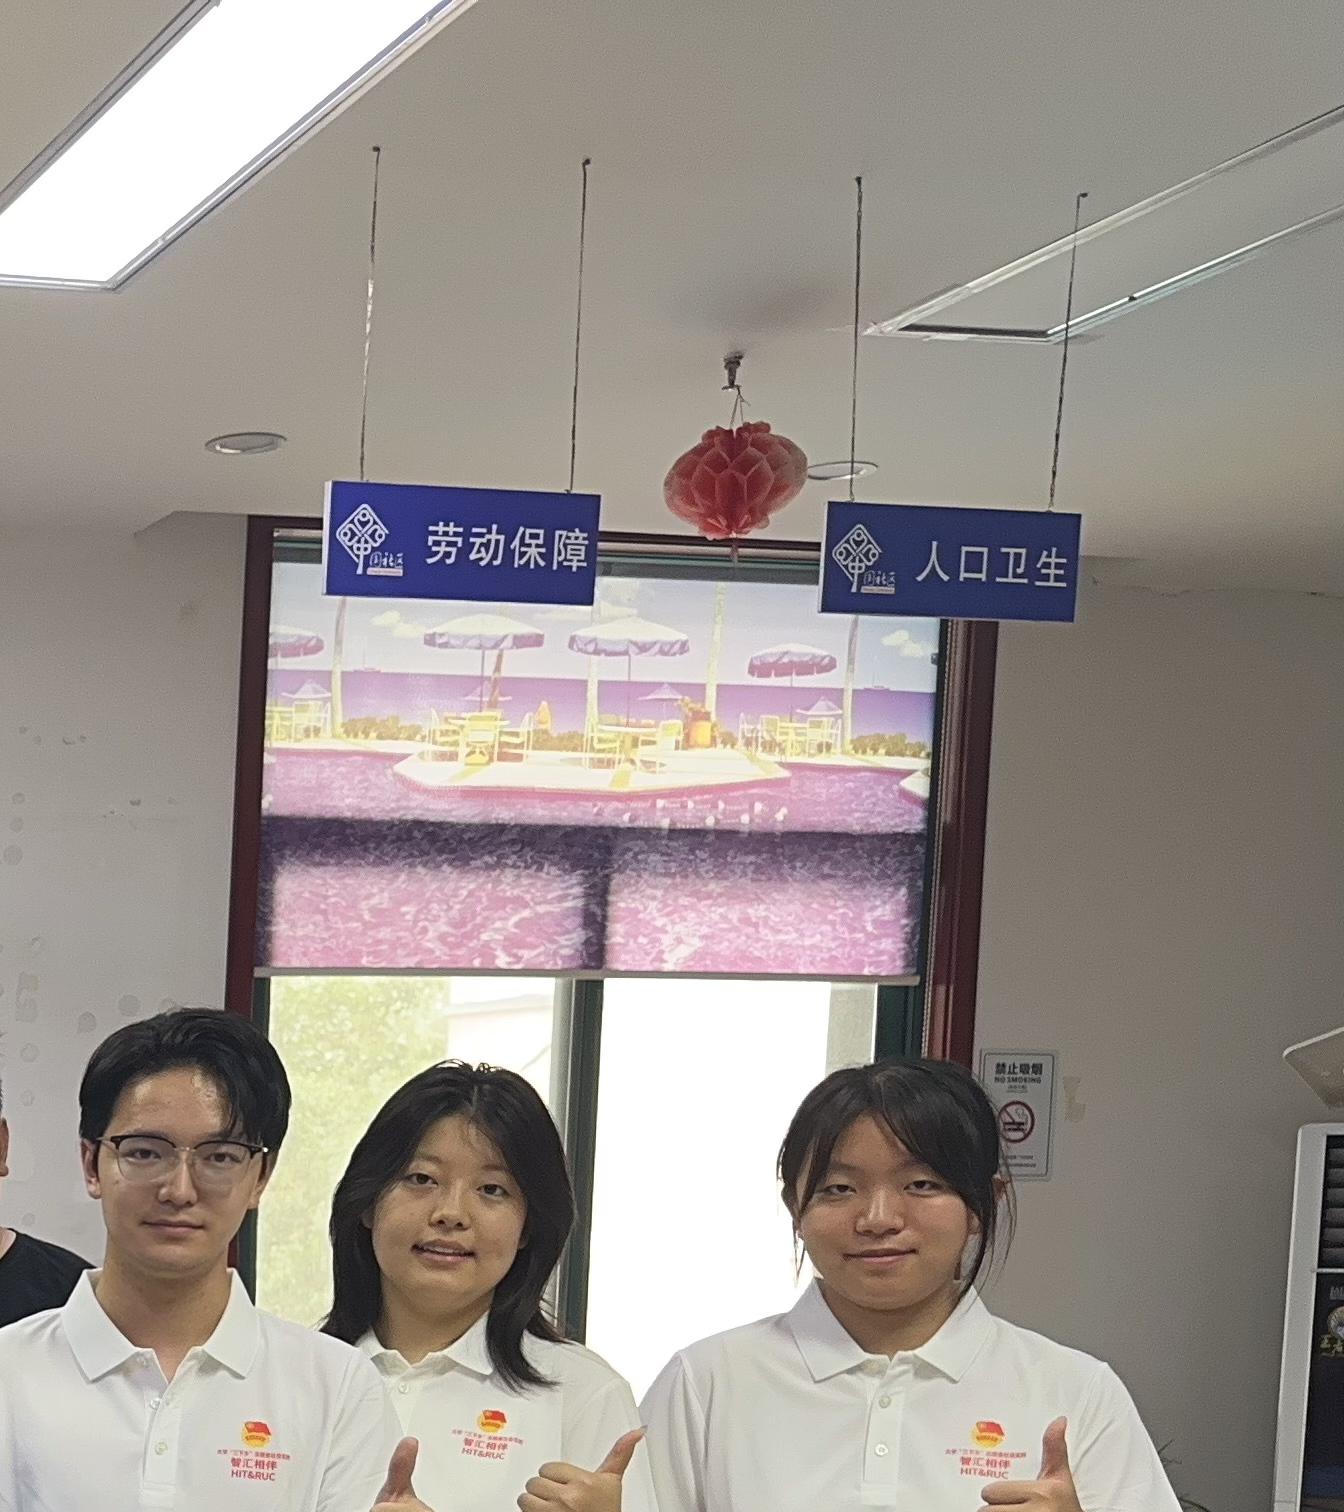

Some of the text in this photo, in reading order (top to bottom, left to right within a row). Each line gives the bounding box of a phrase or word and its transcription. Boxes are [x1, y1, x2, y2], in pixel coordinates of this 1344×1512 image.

[425, 521, 589, 572] 劳动保障
[915, 540, 1068, 587] 人口卫生
[995, 1062, 1043, 1075] 禁止吸烟
[994, 1076, 1006, 1084] NO
[231, 1469, 276, 1482] HIT&RUC
[960, 1467, 1009, 1480] HIT&RUC
